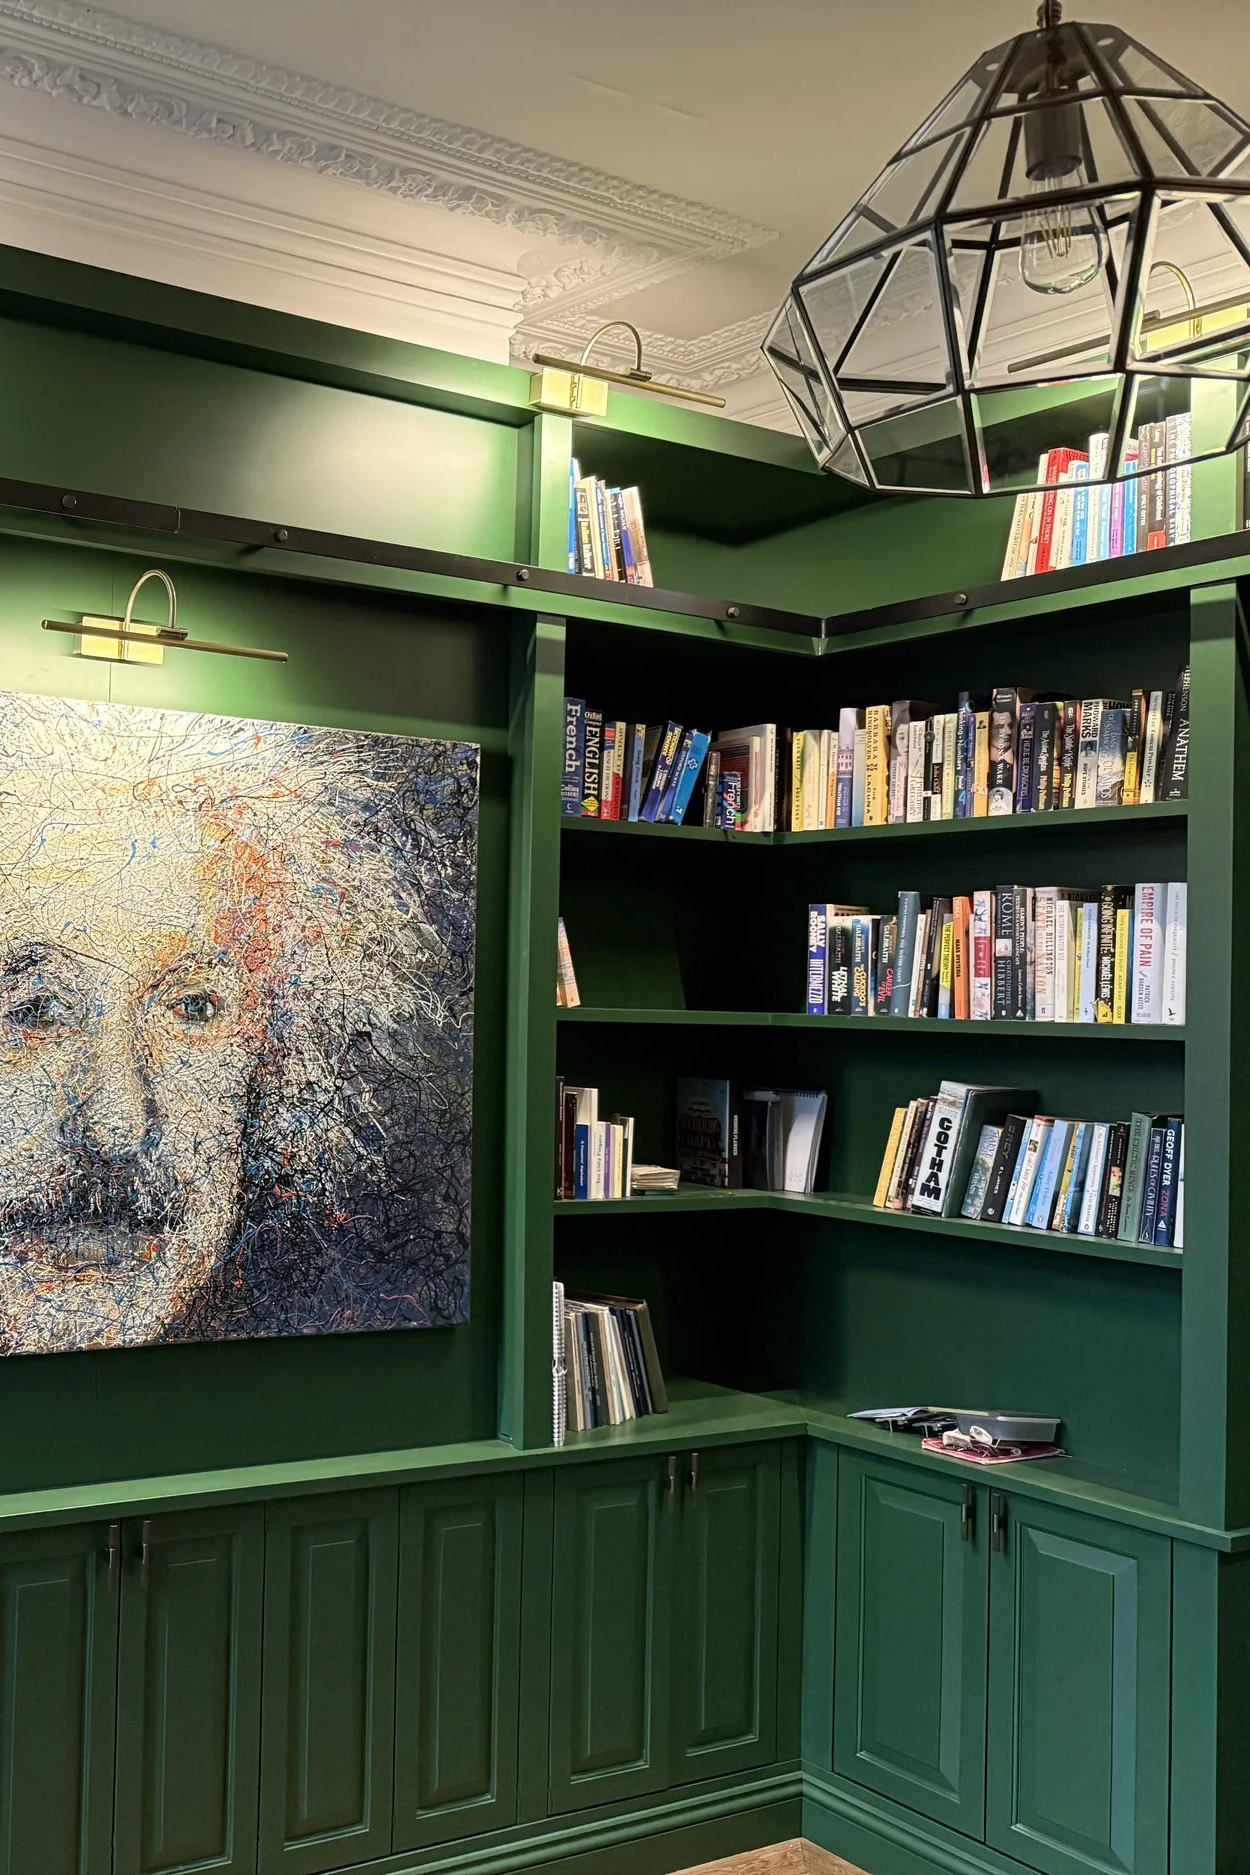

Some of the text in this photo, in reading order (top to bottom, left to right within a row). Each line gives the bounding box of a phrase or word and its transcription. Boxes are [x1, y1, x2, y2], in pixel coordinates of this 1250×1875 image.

[1081, 702, 1093, 739] MARKS
[1091, 705, 1099, 738] HOWARD
[566, 704, 581, 772] French
[1148, 730, 1156, 751] Content
[1172, 718, 1189, 781] ANATHEM
[584, 726, 600, 796] ENGLISH
[1146, 752, 1155, 777] Provider
[1021, 766, 1029, 797] DRAGONS
[1038, 775, 1049, 789] Philip
[1062, 773, 1072, 787] Philip
[723, 782, 737, 824] French
[1039, 790, 1047, 809] Pullman
[1062, 788, 1071, 807] Pullman
[1001, 893, 1013, 936] ROME
[1037, 897, 1046, 931] STATE
[1101, 902, 1113, 923] GOING
[1139, 886, 1154, 967] EMPIRE OF PAIN
[809, 911, 818, 953] ROONEY
[817, 915, 825, 947] SALLY
[943, 937, 951, 953] PERFECT
[809, 959, 823, 1004] INTERMEZZO
[838, 966, 848, 996] LETHAL
[885, 968, 894, 996] CAREER
[997, 960, 1005, 1005] HIBBERT
[1037, 953, 1046, 995] NATION
[1101, 956, 1111, 981] MICHAEL
[832, 971, 841, 1002] WHITE
[877, 987, 885, 1003] EVIL
[1100, 982, 1111, 998] LEWIS
[1002, 1125, 1016, 1159] GREY
[1127, 1119, 1142, 1193] THE CELTIC RING
[919, 1117, 953, 1201] GOTHAM
[1149, 1155, 1159, 1178] RULES
[1160, 1129, 1175, 1217] GEOFF DYER ZONA
[1145, 1187, 1156, 1218] CIVILITY
